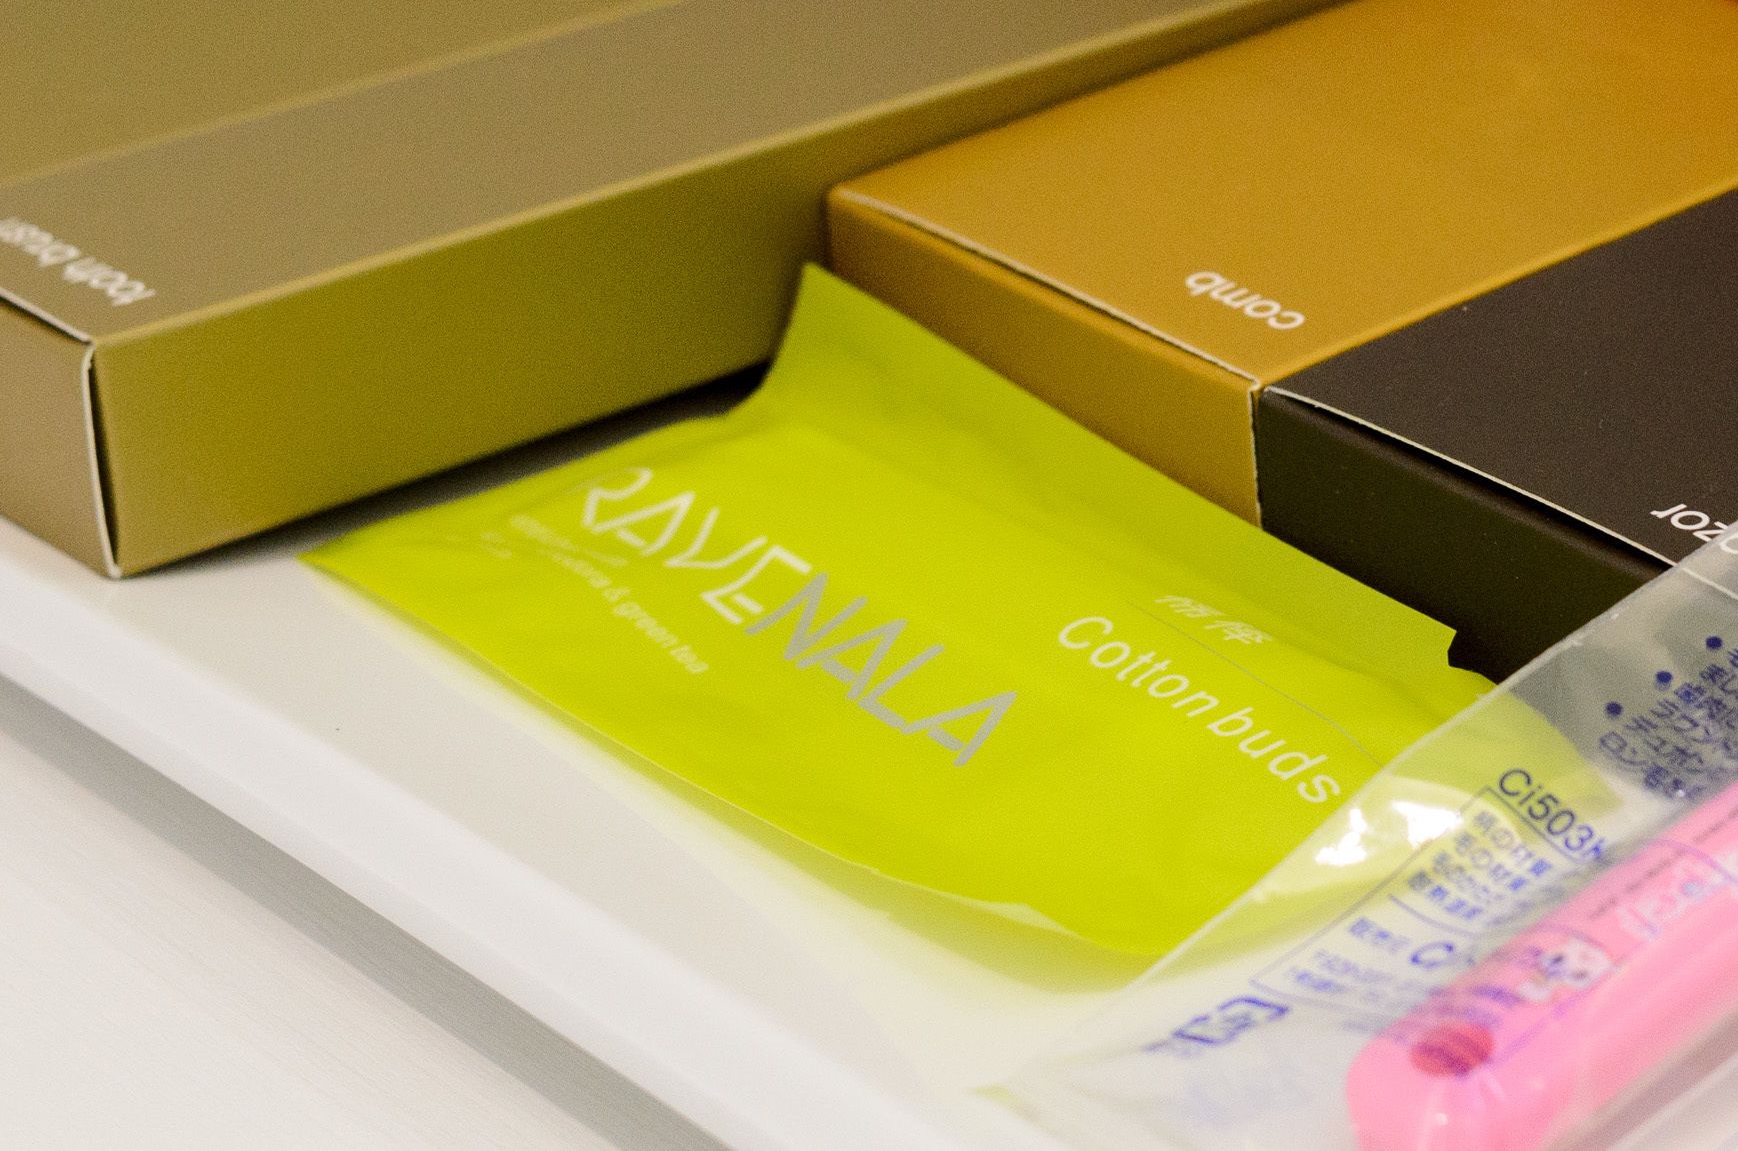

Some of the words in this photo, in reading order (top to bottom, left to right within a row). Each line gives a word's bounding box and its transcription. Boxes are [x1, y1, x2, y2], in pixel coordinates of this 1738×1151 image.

[1184, 270, 1306, 330] comb
[581, 465, 1019, 769] RAVENALA
[1057, 615, 1221, 719] Cotton
[1206, 706, 1342, 806] buds
